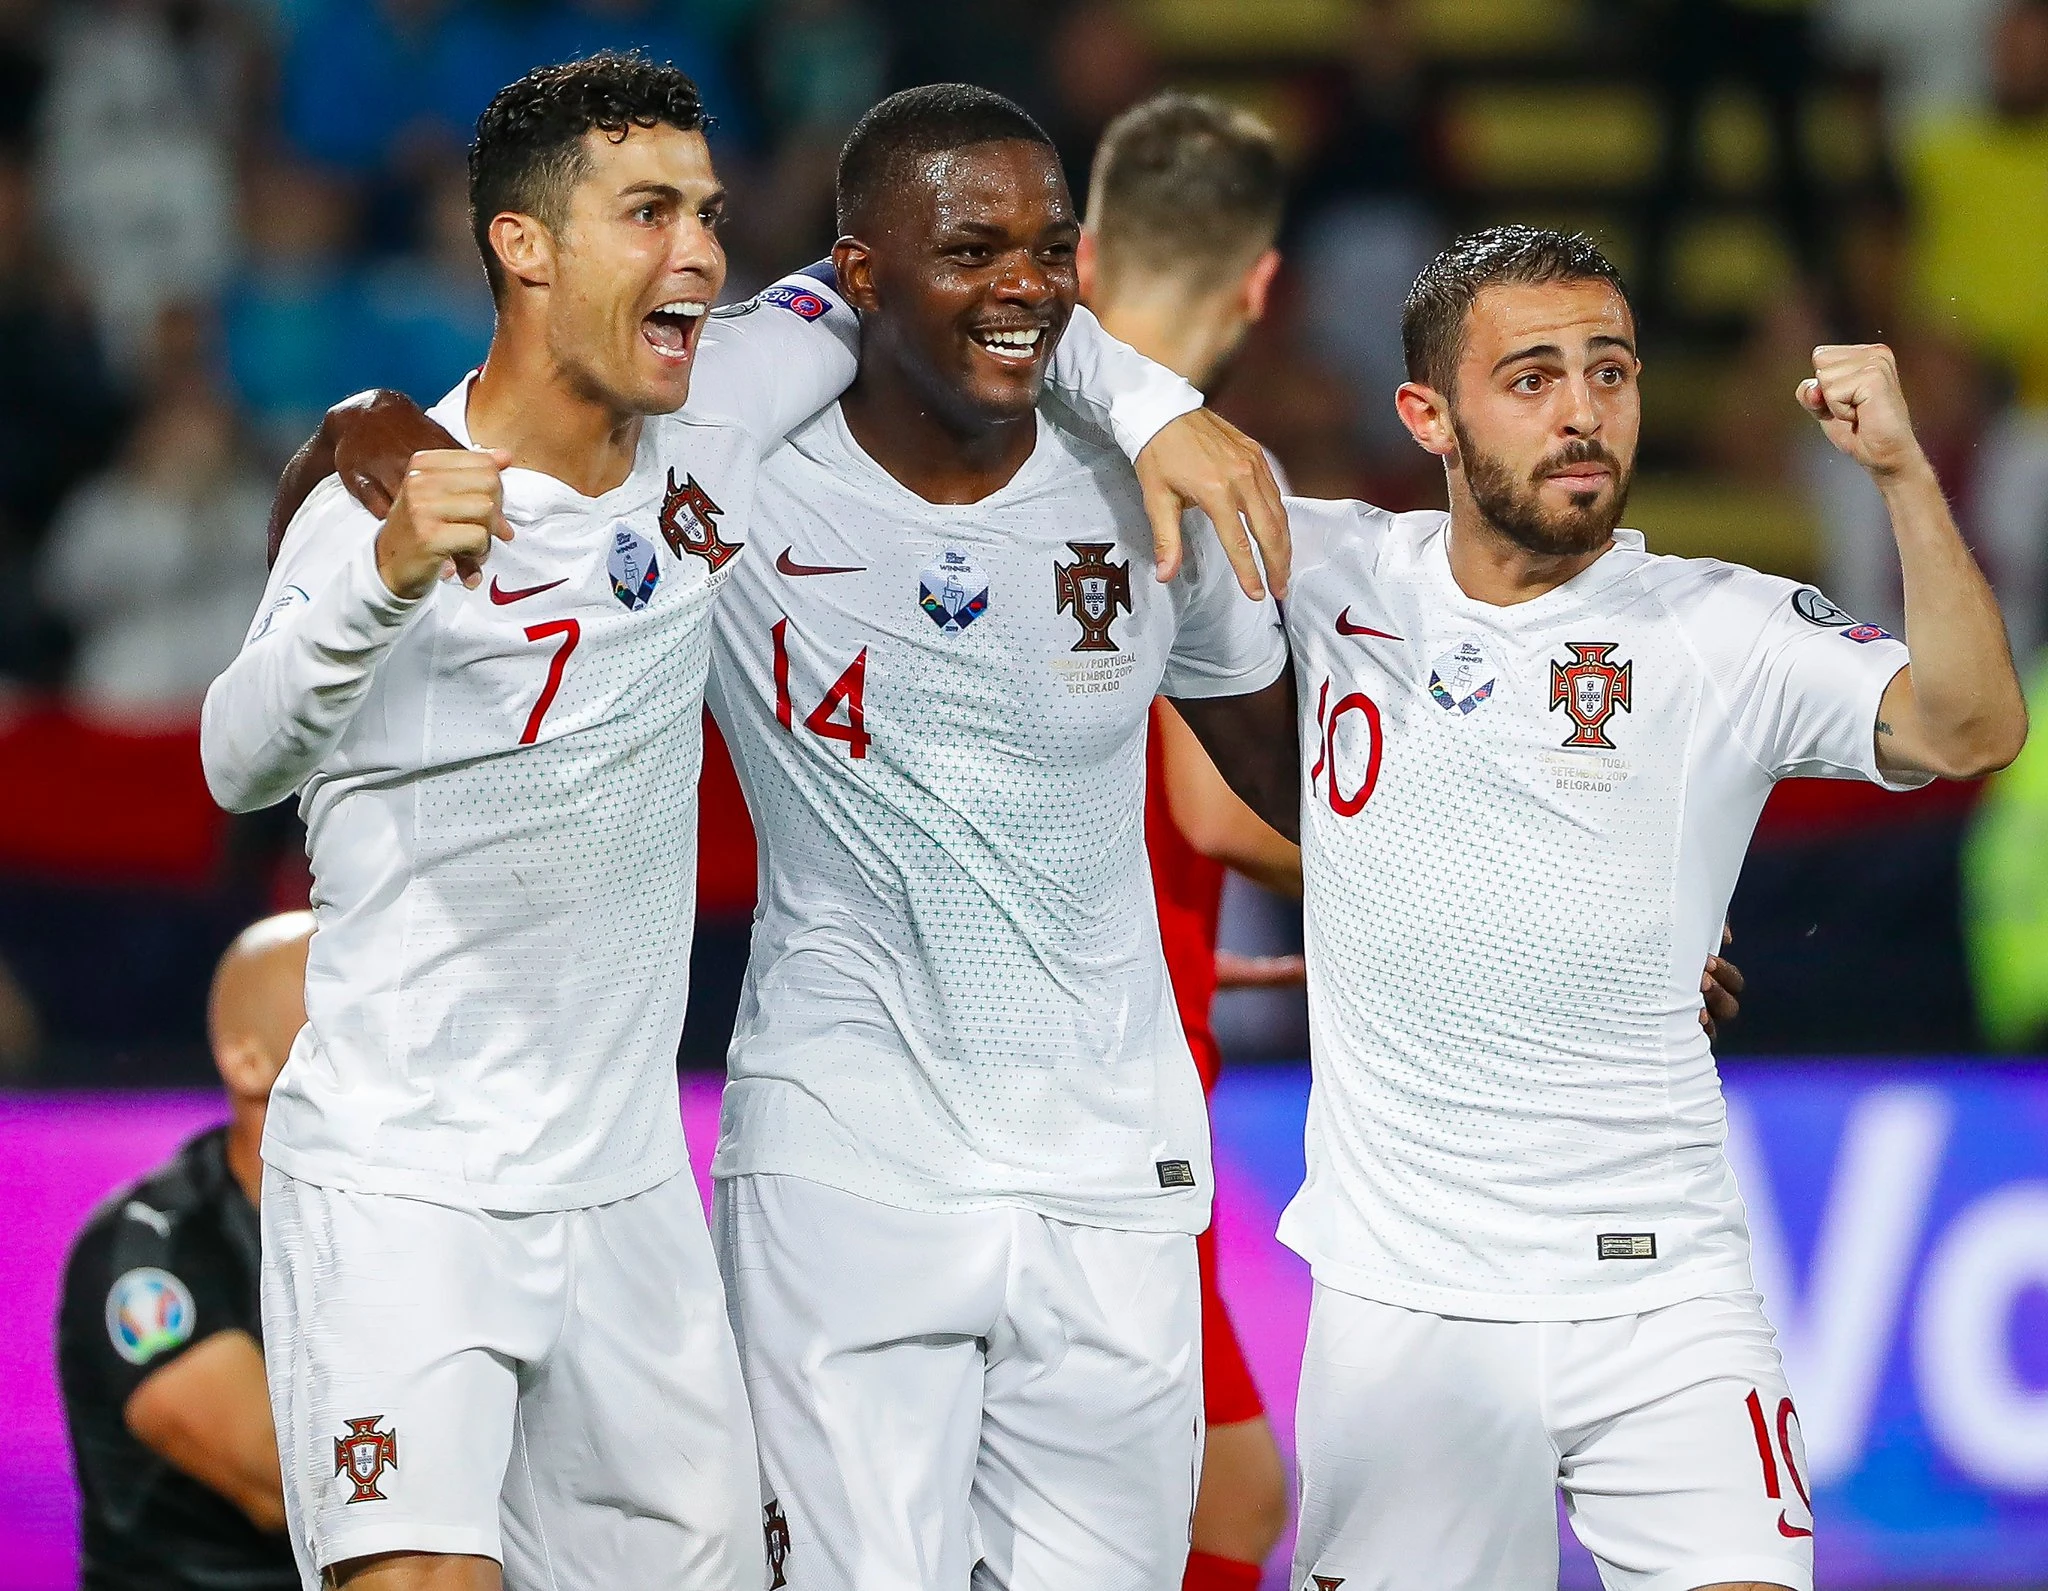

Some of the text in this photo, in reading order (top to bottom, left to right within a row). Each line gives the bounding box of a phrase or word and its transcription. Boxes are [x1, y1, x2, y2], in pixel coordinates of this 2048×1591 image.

[519, 618, 580, 744] 7
[770, 616, 871, 759] 14
[1067, 681, 1119, 693] BELGRADO
[1311, 675, 1383, 817] 10
[1556, 779, 1611, 792] BELGRADO
